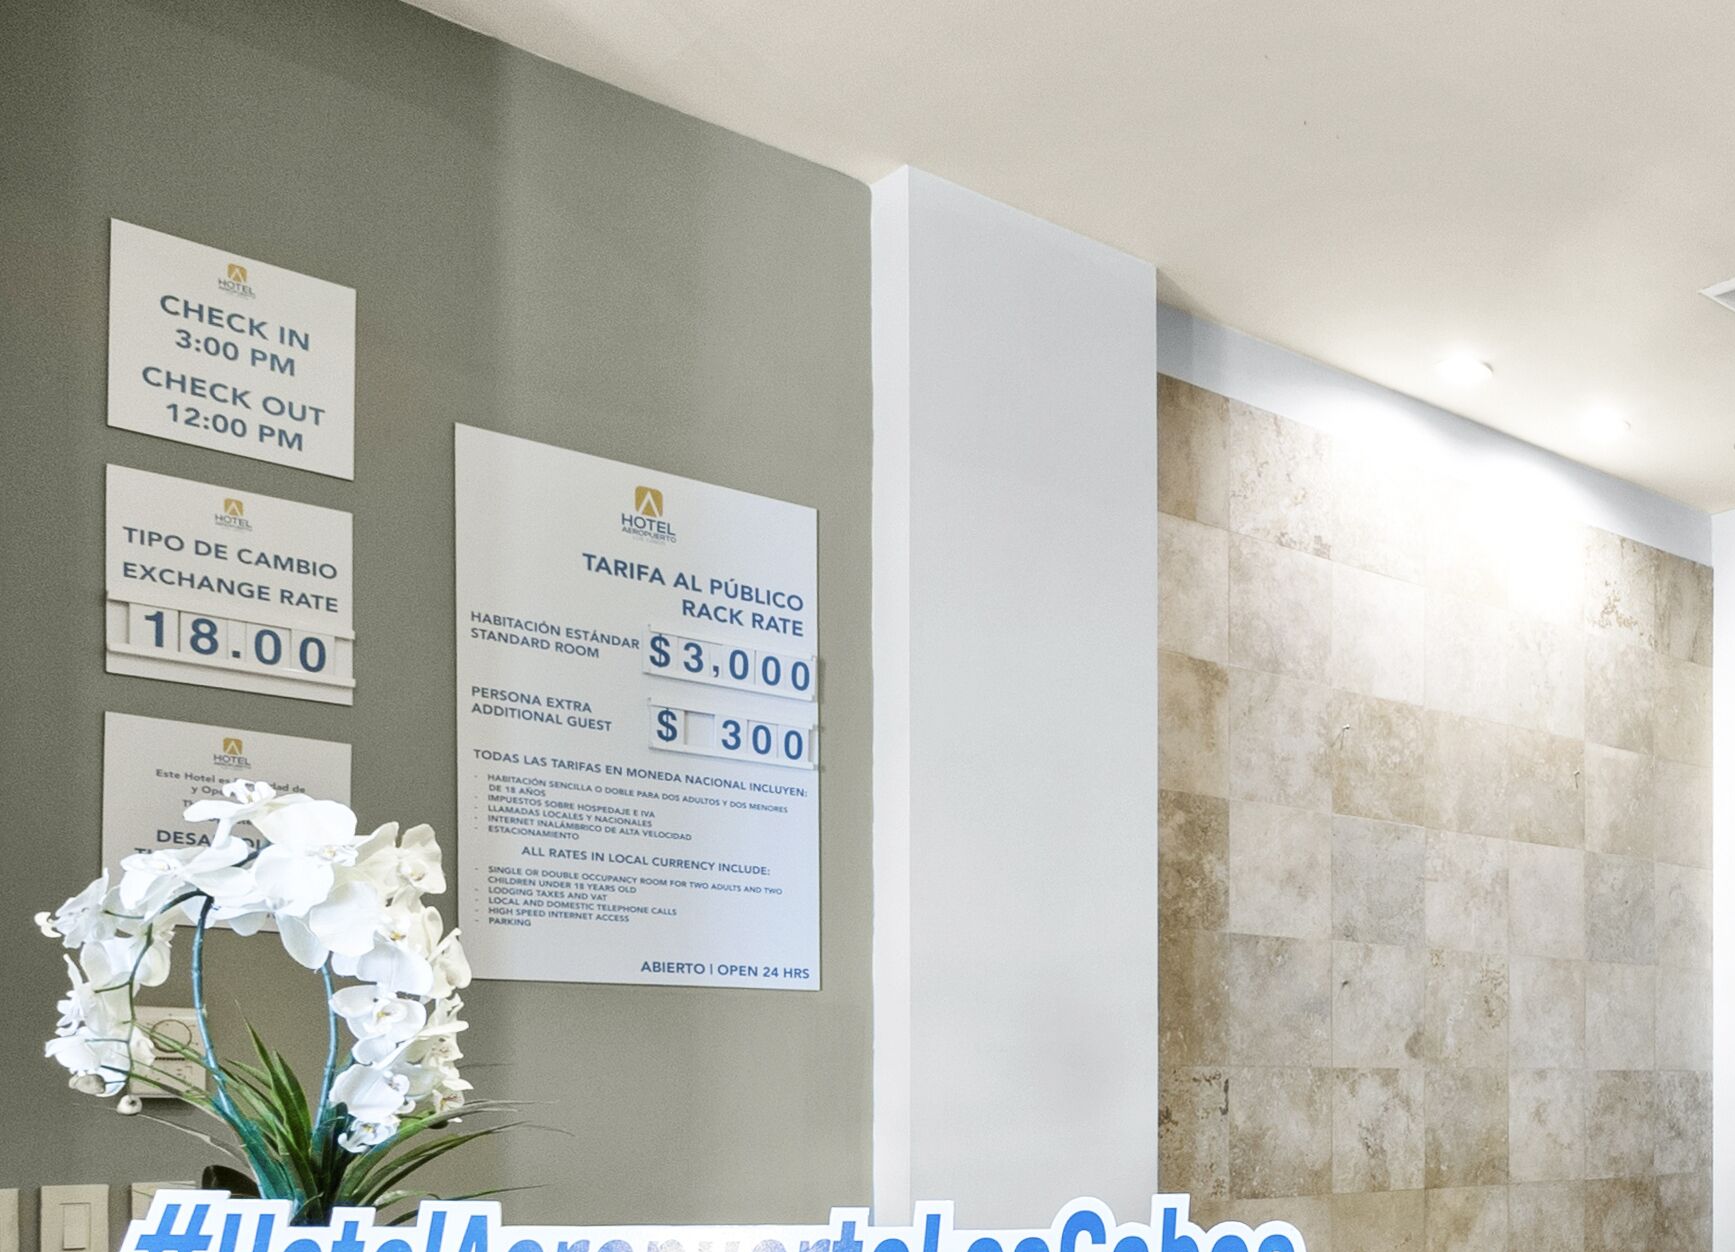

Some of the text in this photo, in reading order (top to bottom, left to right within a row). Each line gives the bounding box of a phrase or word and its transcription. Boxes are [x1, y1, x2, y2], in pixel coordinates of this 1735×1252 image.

[158, 294, 310, 351] CHECK IN
[174, 328, 295, 376] 3:00 PM
[141, 366, 326, 425] CHECK OUT
[165, 403, 303, 451] 12:00 PM
[213, 513, 253, 528] HOTEL
[620, 513, 676, 536] HOTEL
[121, 526, 338, 579] TIPO DE CAMBIO
[122, 561, 339, 613] EXCHANGE RATE
[581, 552, 804, 611] TARIFA AL PÚBLICO
[470, 611, 640, 649] HABITACIÓN ESTÁNDAR
[681, 599, 804, 637] RACK RATE
[144, 611, 326, 673] 18.00
[469, 627, 600, 658] STANDARD ROOM
[649, 633, 810, 692] $3,000
[470, 685, 593, 713] PERSONA EXTRA
[470, 702, 612, 731] ADDITIONAL GUEST
[213, 754, 251, 766] HOTEL
[472, 748, 807, 797] TODAS LAS TARIFAS EN MONEDA NACIONAL INCLUYEN:
[155, 769, 181, 779] Este
[184, 770, 215, 783] Hotel
[486, 794, 543, 807] IMPUESTOS
[543, 799, 575, 810] SOBRE
[576, 803, 631, 815] HOSPEDAJE
[639, 810, 656, 818] IVA
[547, 780, 593, 792] SENCILLA
[593, 785, 603, 793] O
[603, 786, 635, 797] DOBLE
[635, 790, 660, 799] PARA
[660, 792, 681, 802] DOS
[681, 795, 721, 806] ADULTOS
[728, 800, 748, 809] DOS
[747, 802, 788, 813] MENORES
[486, 804, 541, 816] LLAMADAS
[541, 810, 585, 821] LOCALES
[593, 815, 653, 827] NACIONALES
[486, 814, 535, 825] INTERNET
[603, 825, 617, 834] DE
[617, 827, 641, 836] ALTA
[641, 829, 693, 840] VELOCIDAD
[487, 824, 580, 840] ESTACIONAMIENTO
[520, 846, 770, 875] ALL RATES IN LOCAL CURRENCY INCLUDE:
[486, 875, 638, 894] CHILDREN UNDER 18 YEARS OLD
[487, 865, 523, 875] SINGLE
[523, 868, 540, 876] OR
[540, 869, 580, 880] DOUBLE
[580, 872, 638, 884] OCCUPANCY
[638, 877, 668, 886] ROOM
[668, 879, 688, 887] FOR
[688, 881, 710, 889] TWO
[709, 883, 742, 892] ADULTS
[762, 887, 783, 895] TWO
[487, 886, 608, 901] LODGING TAXES AND VAT
[487, 896, 677, 915] LOCAL AND DOMESTIC TELEPHONE CALLS
[487, 907, 630, 922] HIGH SPEED INTERNET ACCESS
[487, 916, 532, 926] PARKING
[639, 960, 706, 974] ABIERTO
[716, 964, 759, 977] OPEN
[761, 966, 780, 977] 24
[782, 967, 810, 979] HRS
